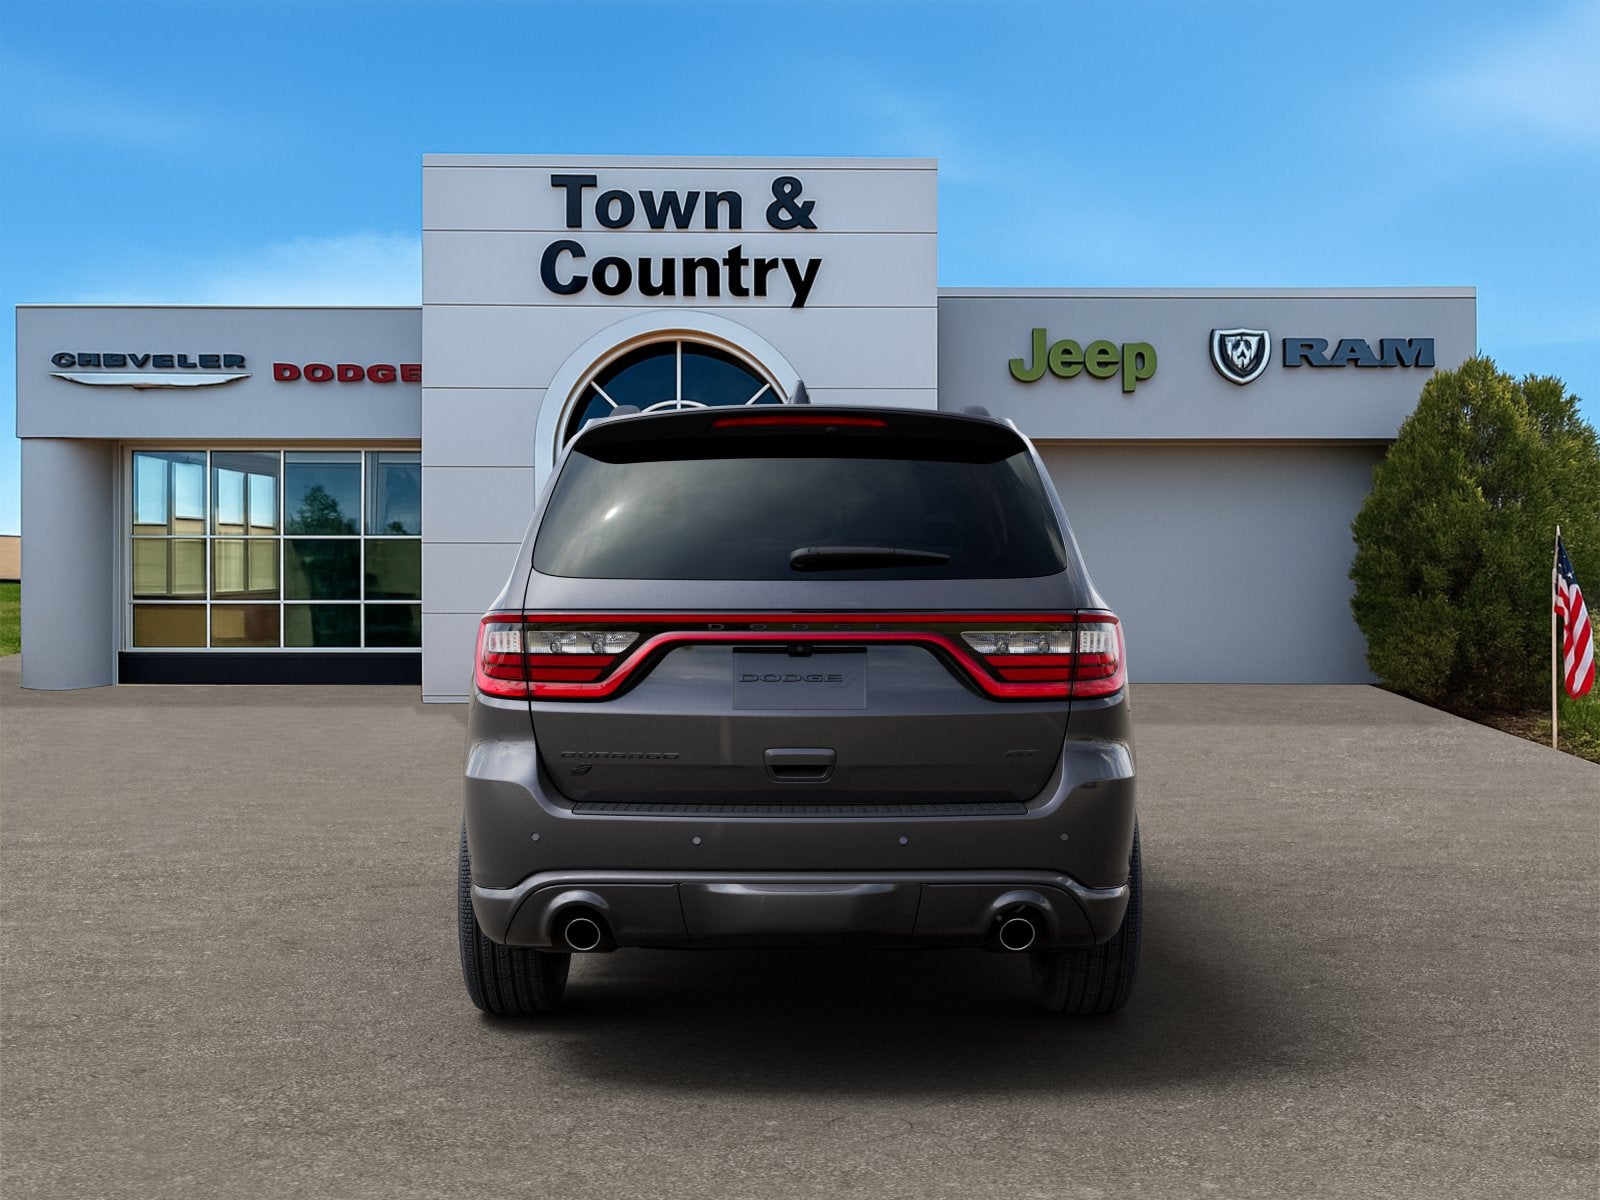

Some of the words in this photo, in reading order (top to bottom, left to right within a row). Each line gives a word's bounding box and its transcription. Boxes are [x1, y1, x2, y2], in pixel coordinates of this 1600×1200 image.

[550, 173, 743, 230] Town
[765, 175, 818, 230] &
[539, 239, 823, 309] Country
[1009, 327, 1158, 393] Jeep
[1282, 337, 1436, 368] RAM
[272, 362, 422, 384] DODGE
[738, 673, 844, 684] DODGE
[560, 750, 680, 760] DURANGO
